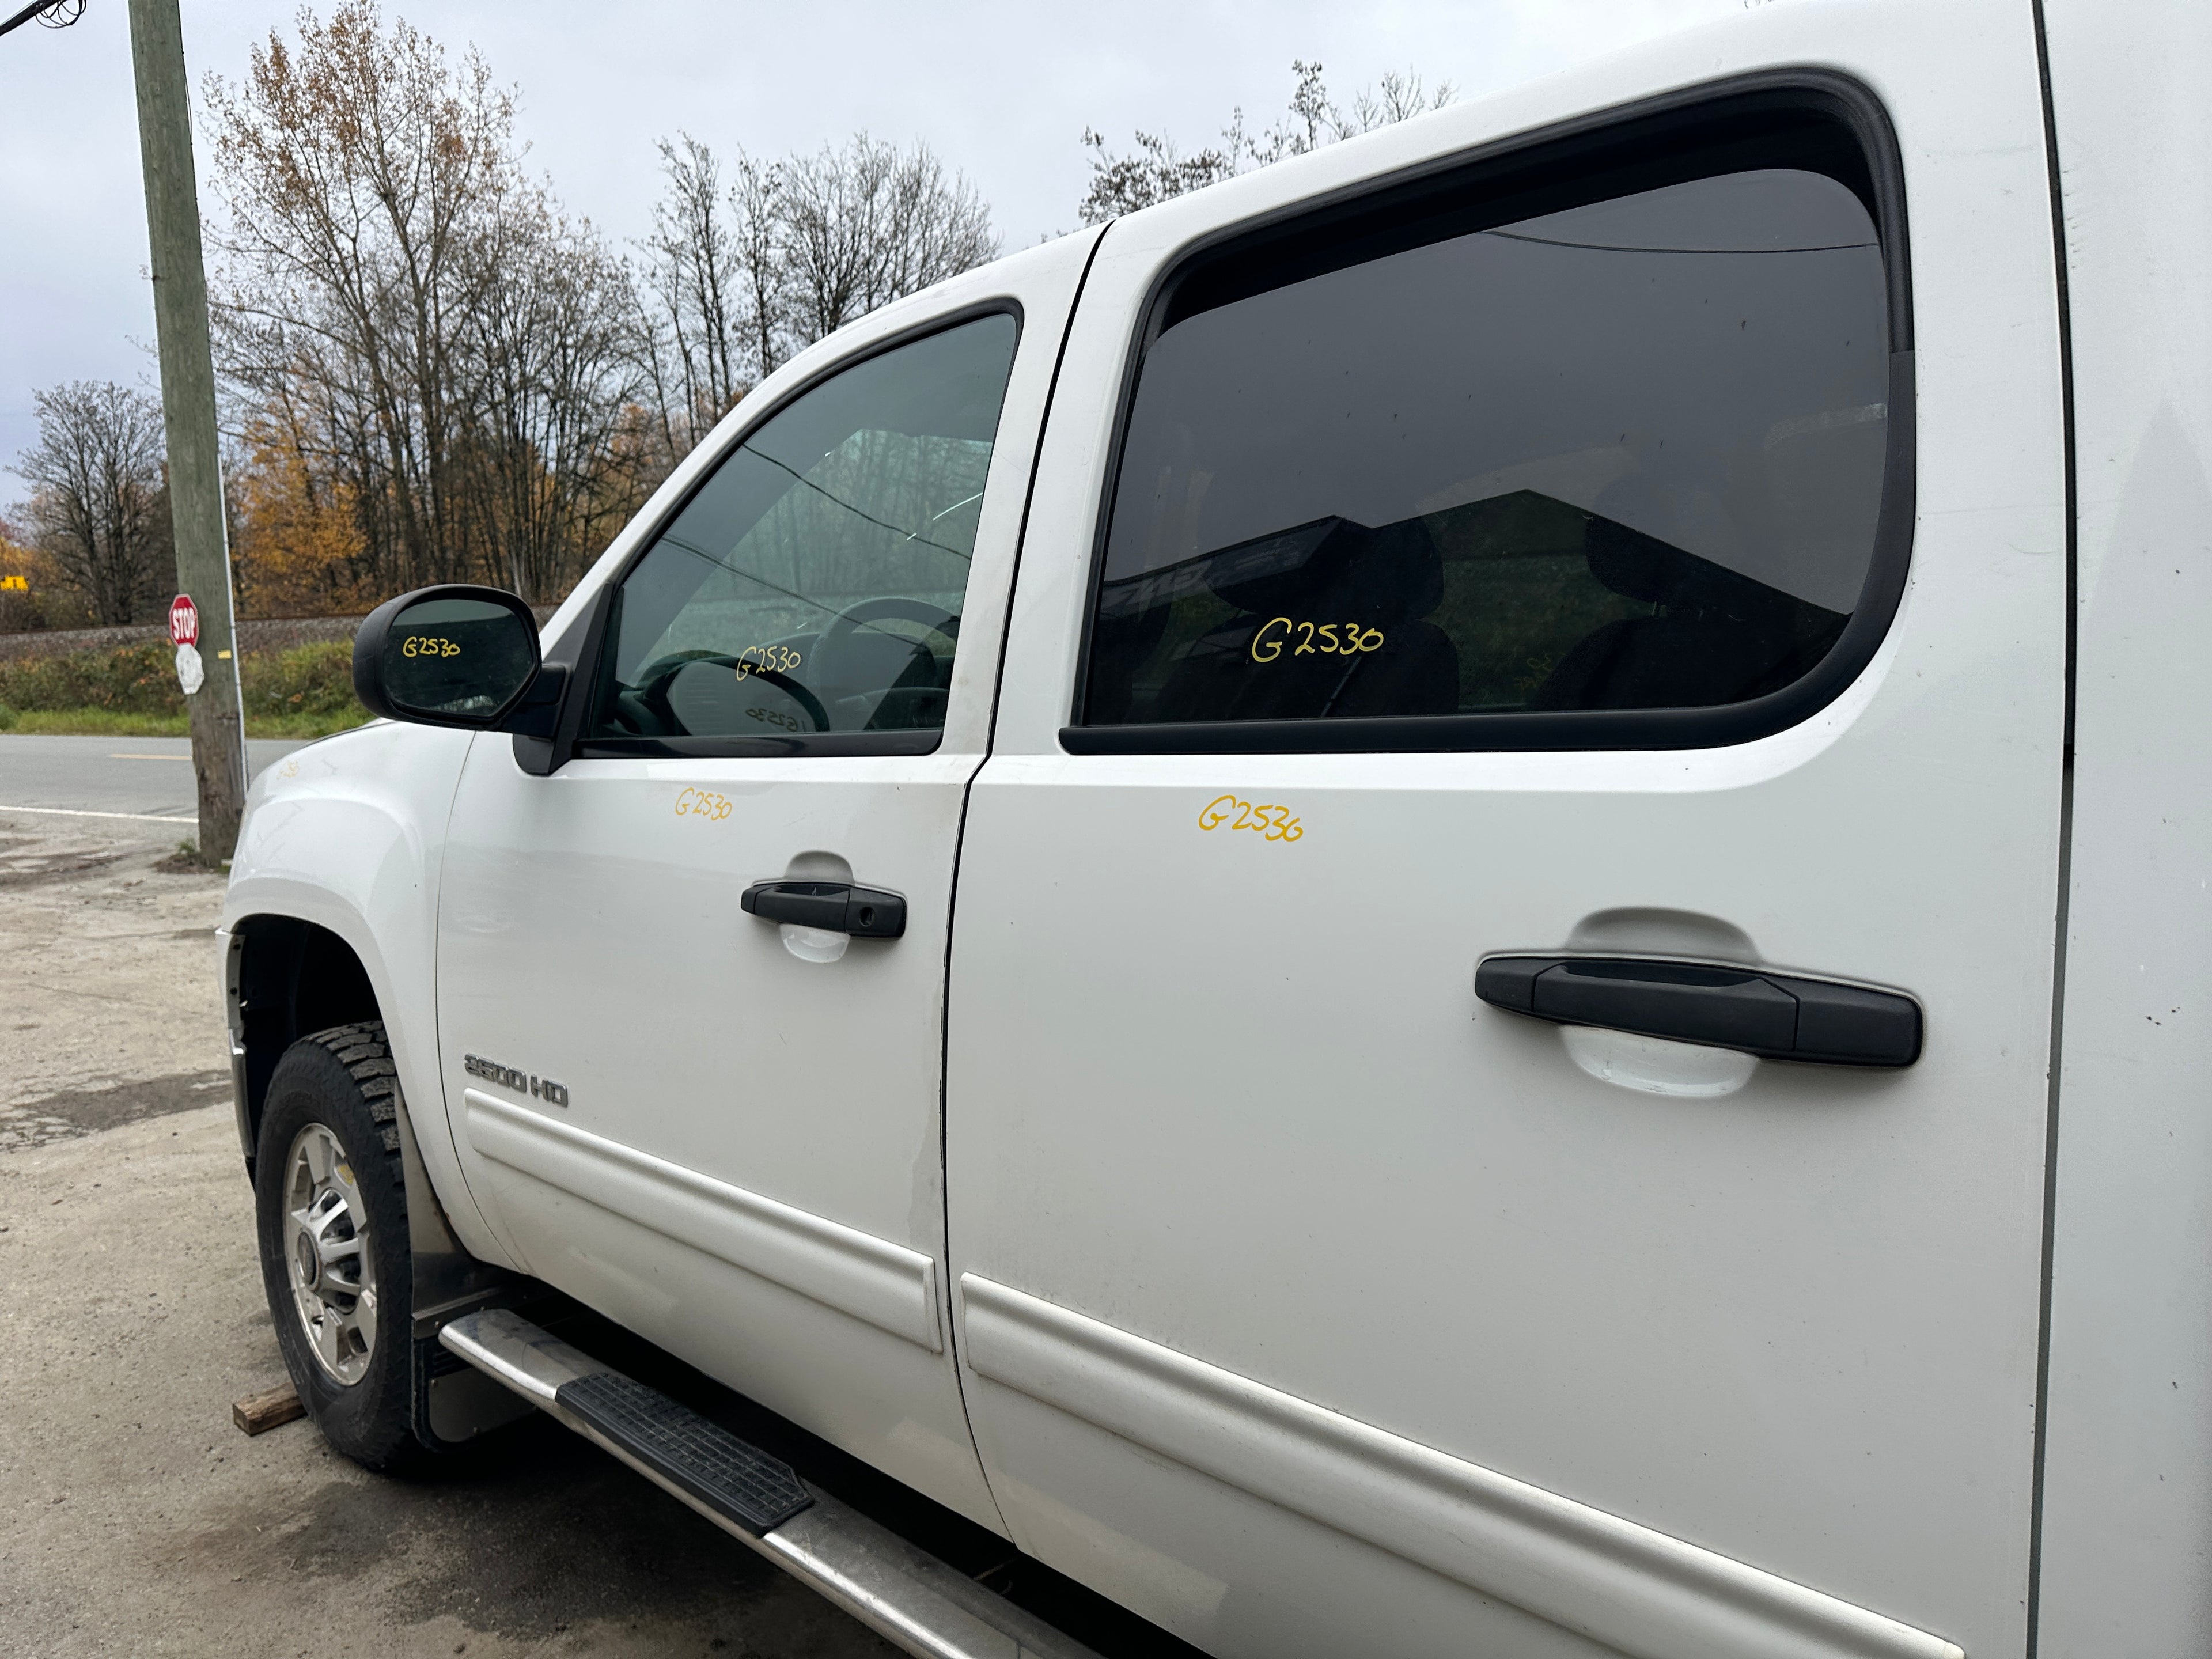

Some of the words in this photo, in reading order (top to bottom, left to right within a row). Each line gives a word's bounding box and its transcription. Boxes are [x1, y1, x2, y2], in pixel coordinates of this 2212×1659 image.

[173, 607, 195, 640] STOP
[1252, 617, 1384, 662] G2530
[403, 636, 460, 657] G2530
[736, 646, 801, 681] G2530
[675, 787, 732, 821] G2530
[530, 1074, 569, 1108] HD
